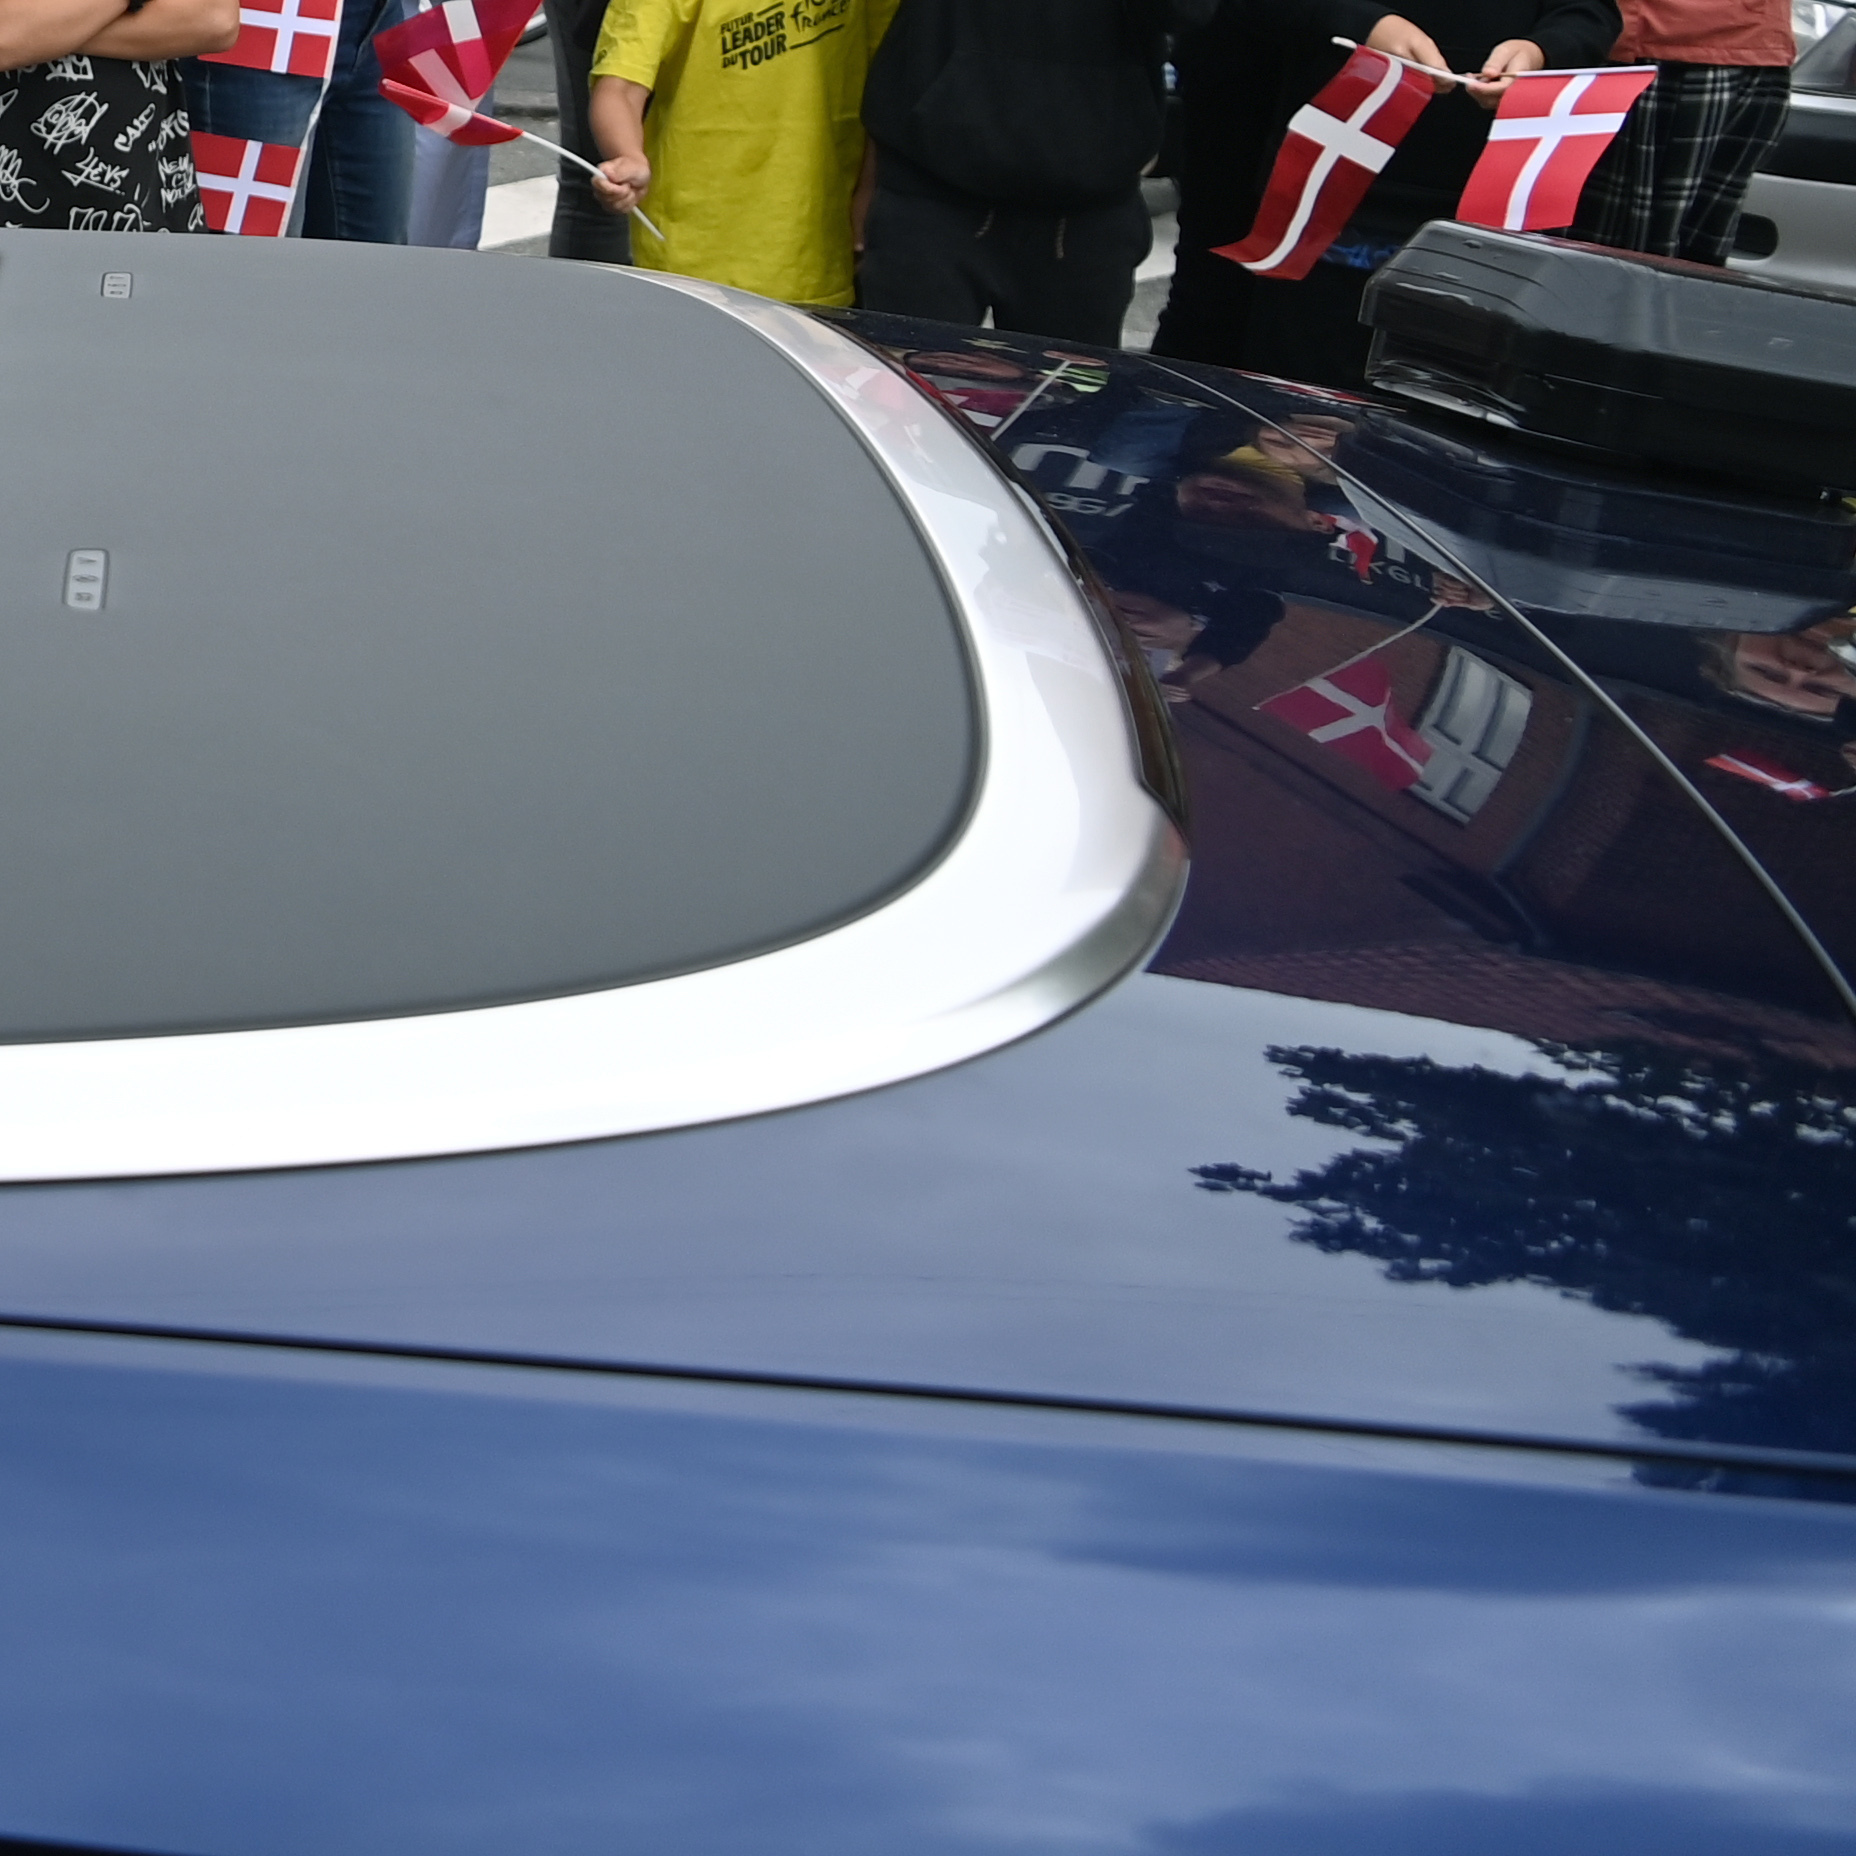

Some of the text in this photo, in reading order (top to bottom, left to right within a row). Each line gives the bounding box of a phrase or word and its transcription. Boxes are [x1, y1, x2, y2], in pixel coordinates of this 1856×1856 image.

[720, 11, 754, 35] FUTUR
[721, 11, 786, 55] LEADER
[722, 33, 787, 70] DU TOUR
